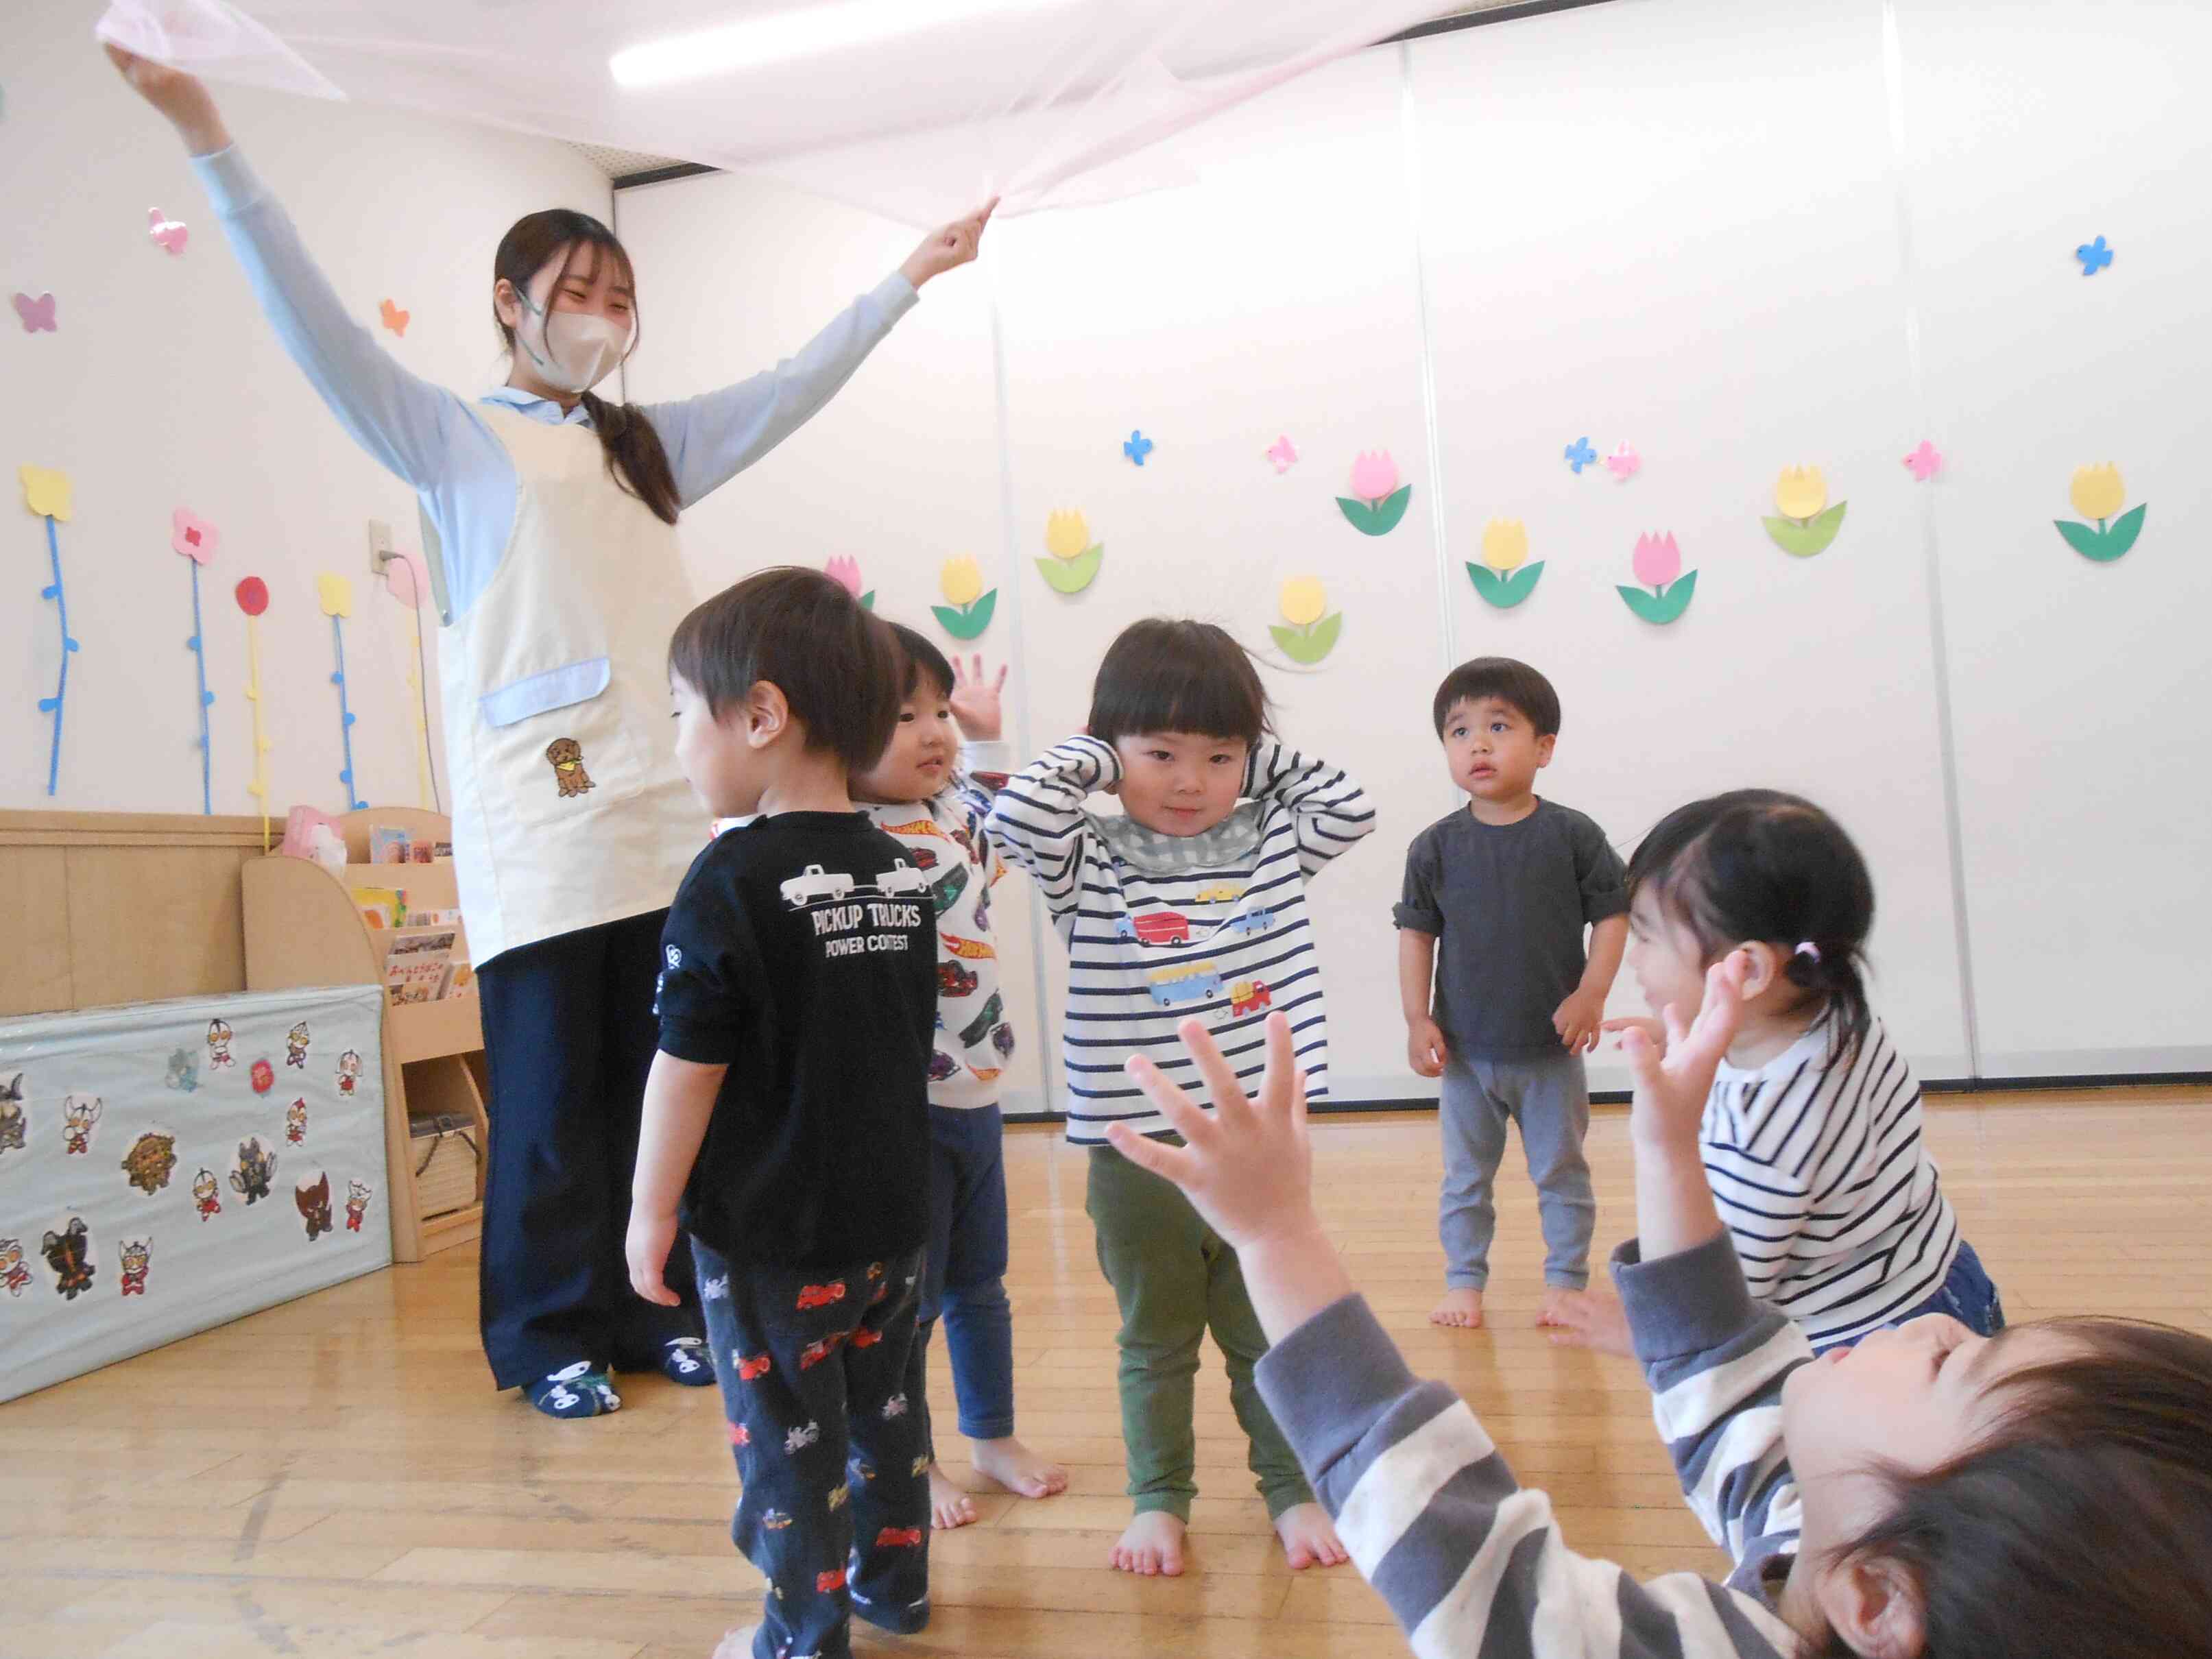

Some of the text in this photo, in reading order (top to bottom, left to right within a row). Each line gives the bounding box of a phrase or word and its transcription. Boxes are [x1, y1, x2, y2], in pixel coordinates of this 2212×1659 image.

[811, 903, 921, 936] PICKUP TRUCKS
[825, 934, 909, 958] POWER COTEST
